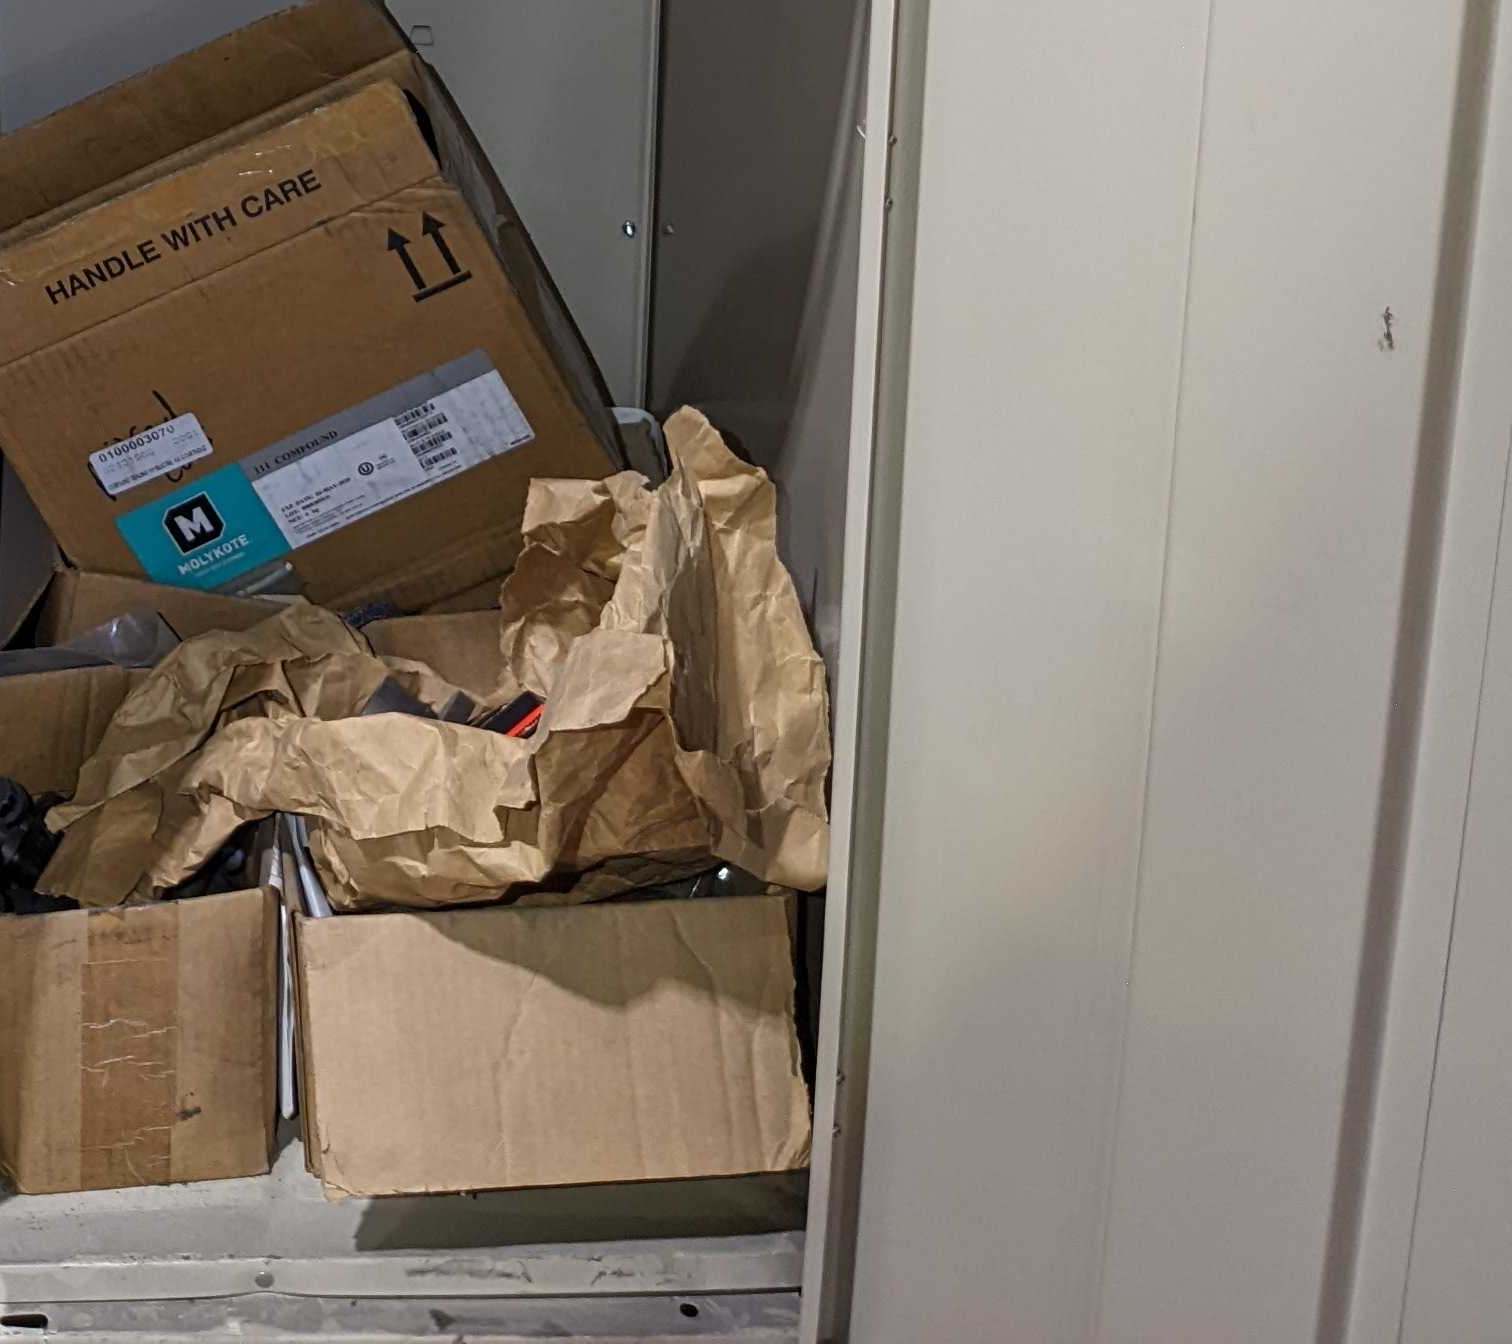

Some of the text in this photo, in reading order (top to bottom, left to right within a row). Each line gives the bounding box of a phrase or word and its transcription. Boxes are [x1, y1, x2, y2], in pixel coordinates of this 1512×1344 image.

[44, 168, 323, 305] HANDLE WITH CARE
[274, 429, 340, 466] COMPOUND
[173, 505, 215, 543] M
[176, 533, 250, 576] MOLYKOTE
